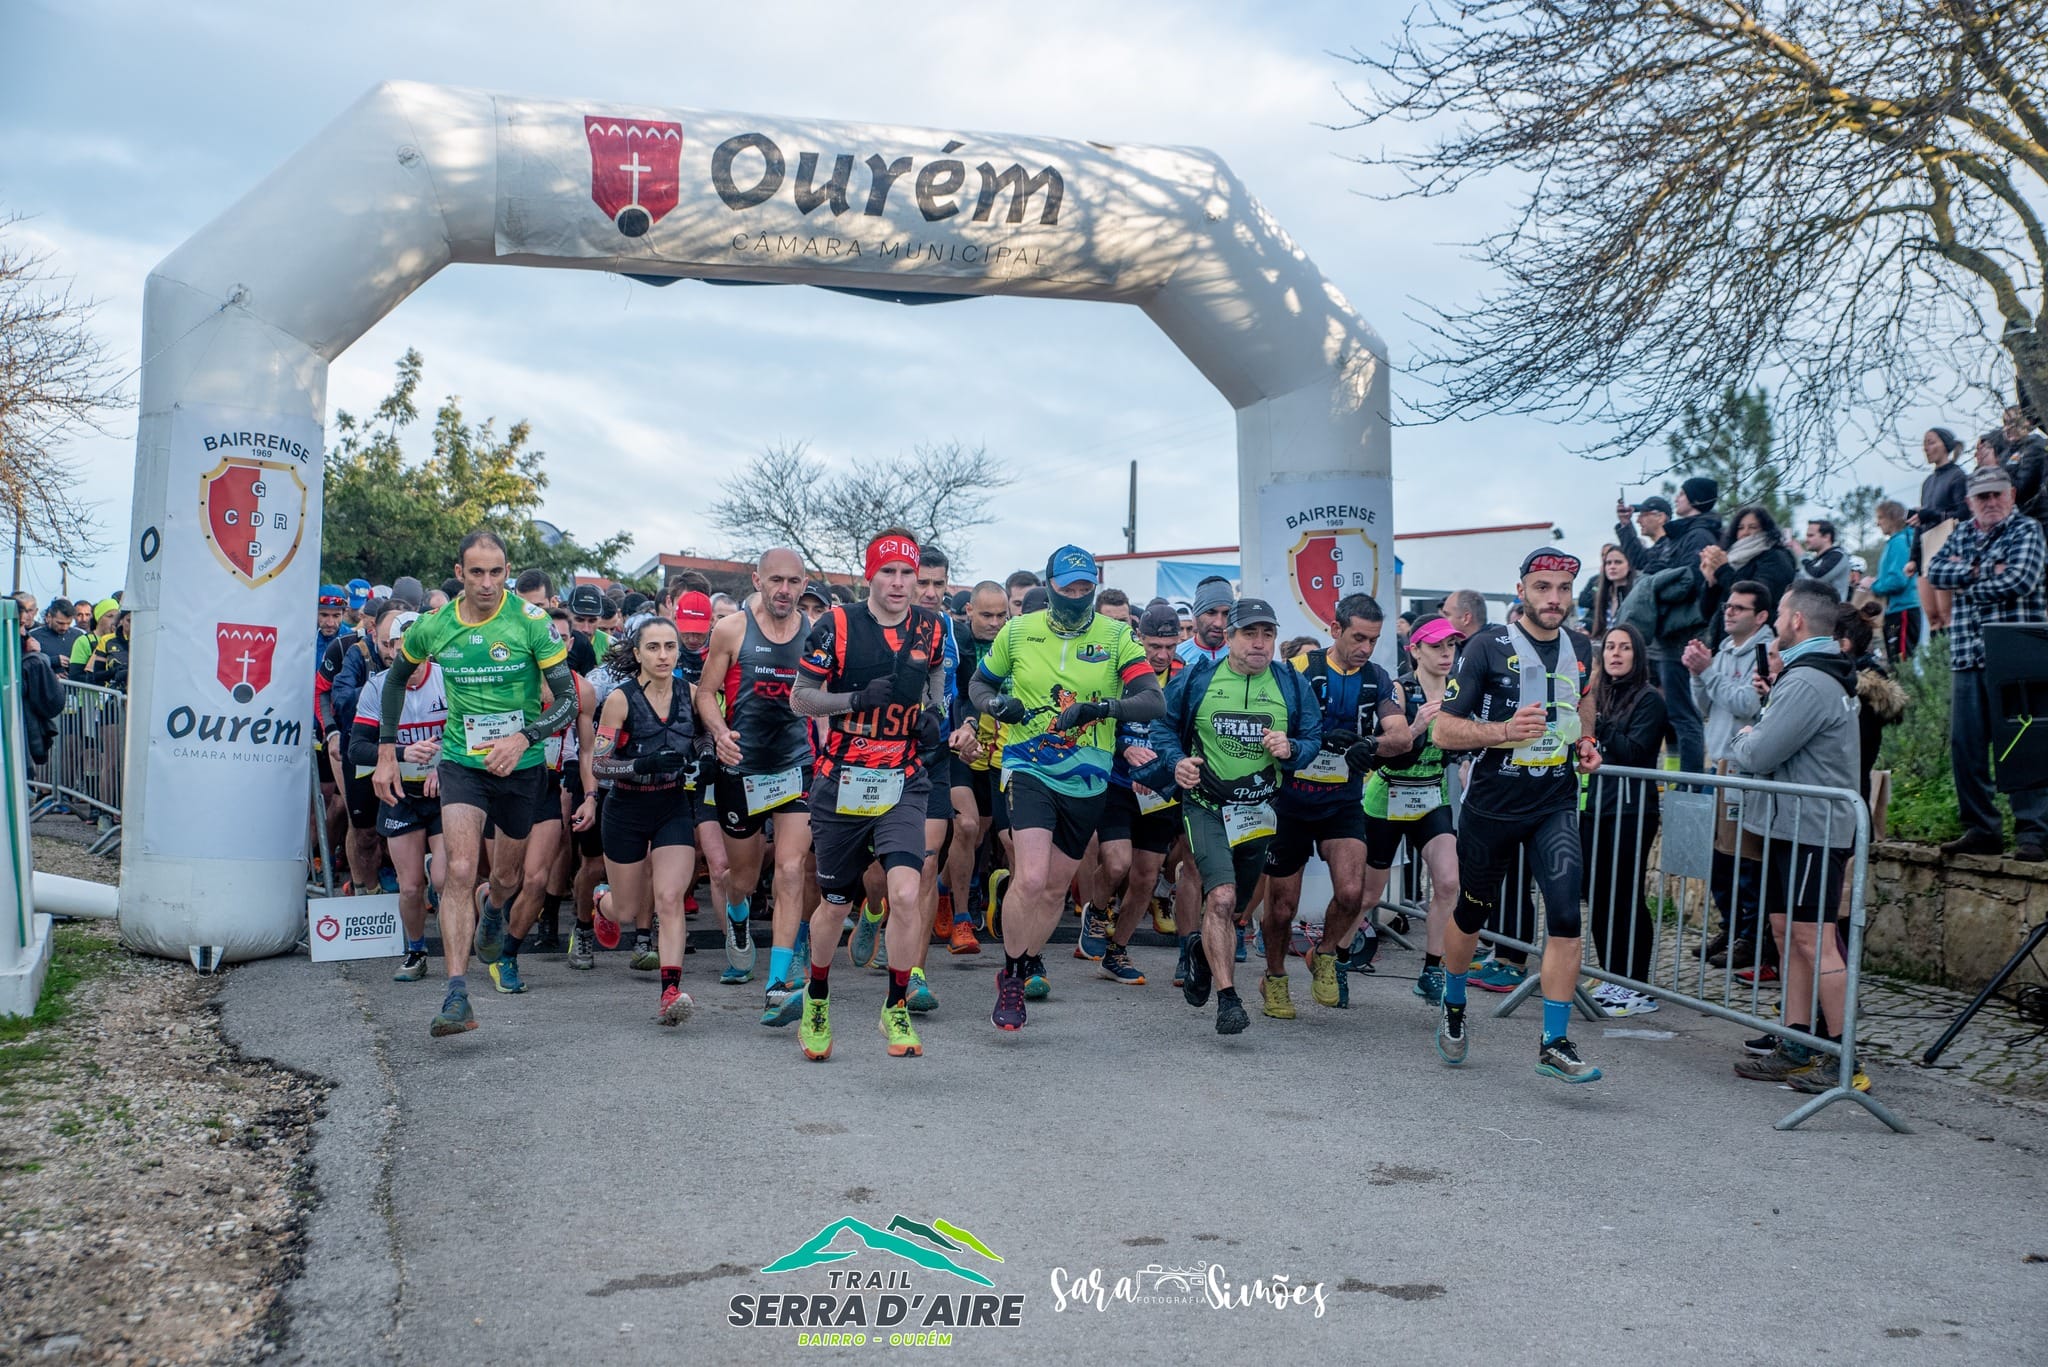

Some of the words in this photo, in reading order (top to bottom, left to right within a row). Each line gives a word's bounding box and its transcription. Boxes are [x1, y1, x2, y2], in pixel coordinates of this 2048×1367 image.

[711, 132, 1065, 226] Ourém
[732, 230, 862, 258] CÂMARA
[879, 242, 1049, 266] MUNICIPAL
[203, 431, 311, 464] BAIRRENSE
[252, 448, 272, 458] 1969
[251, 481, 266, 498] G
[1286, 505, 1377, 529] BAIRRENSE
[1326, 519, 1344, 527] 1969
[247, 541, 262, 557] B
[1330, 547, 1344, 562] G
[167, 705, 301, 746] Ourém
[173, 748, 227, 761] CÂMARA
[232, 752, 295, 764] MUNICIPAL
[345, 911, 394, 926] recorde
[345, 920, 396, 940] pessoal
